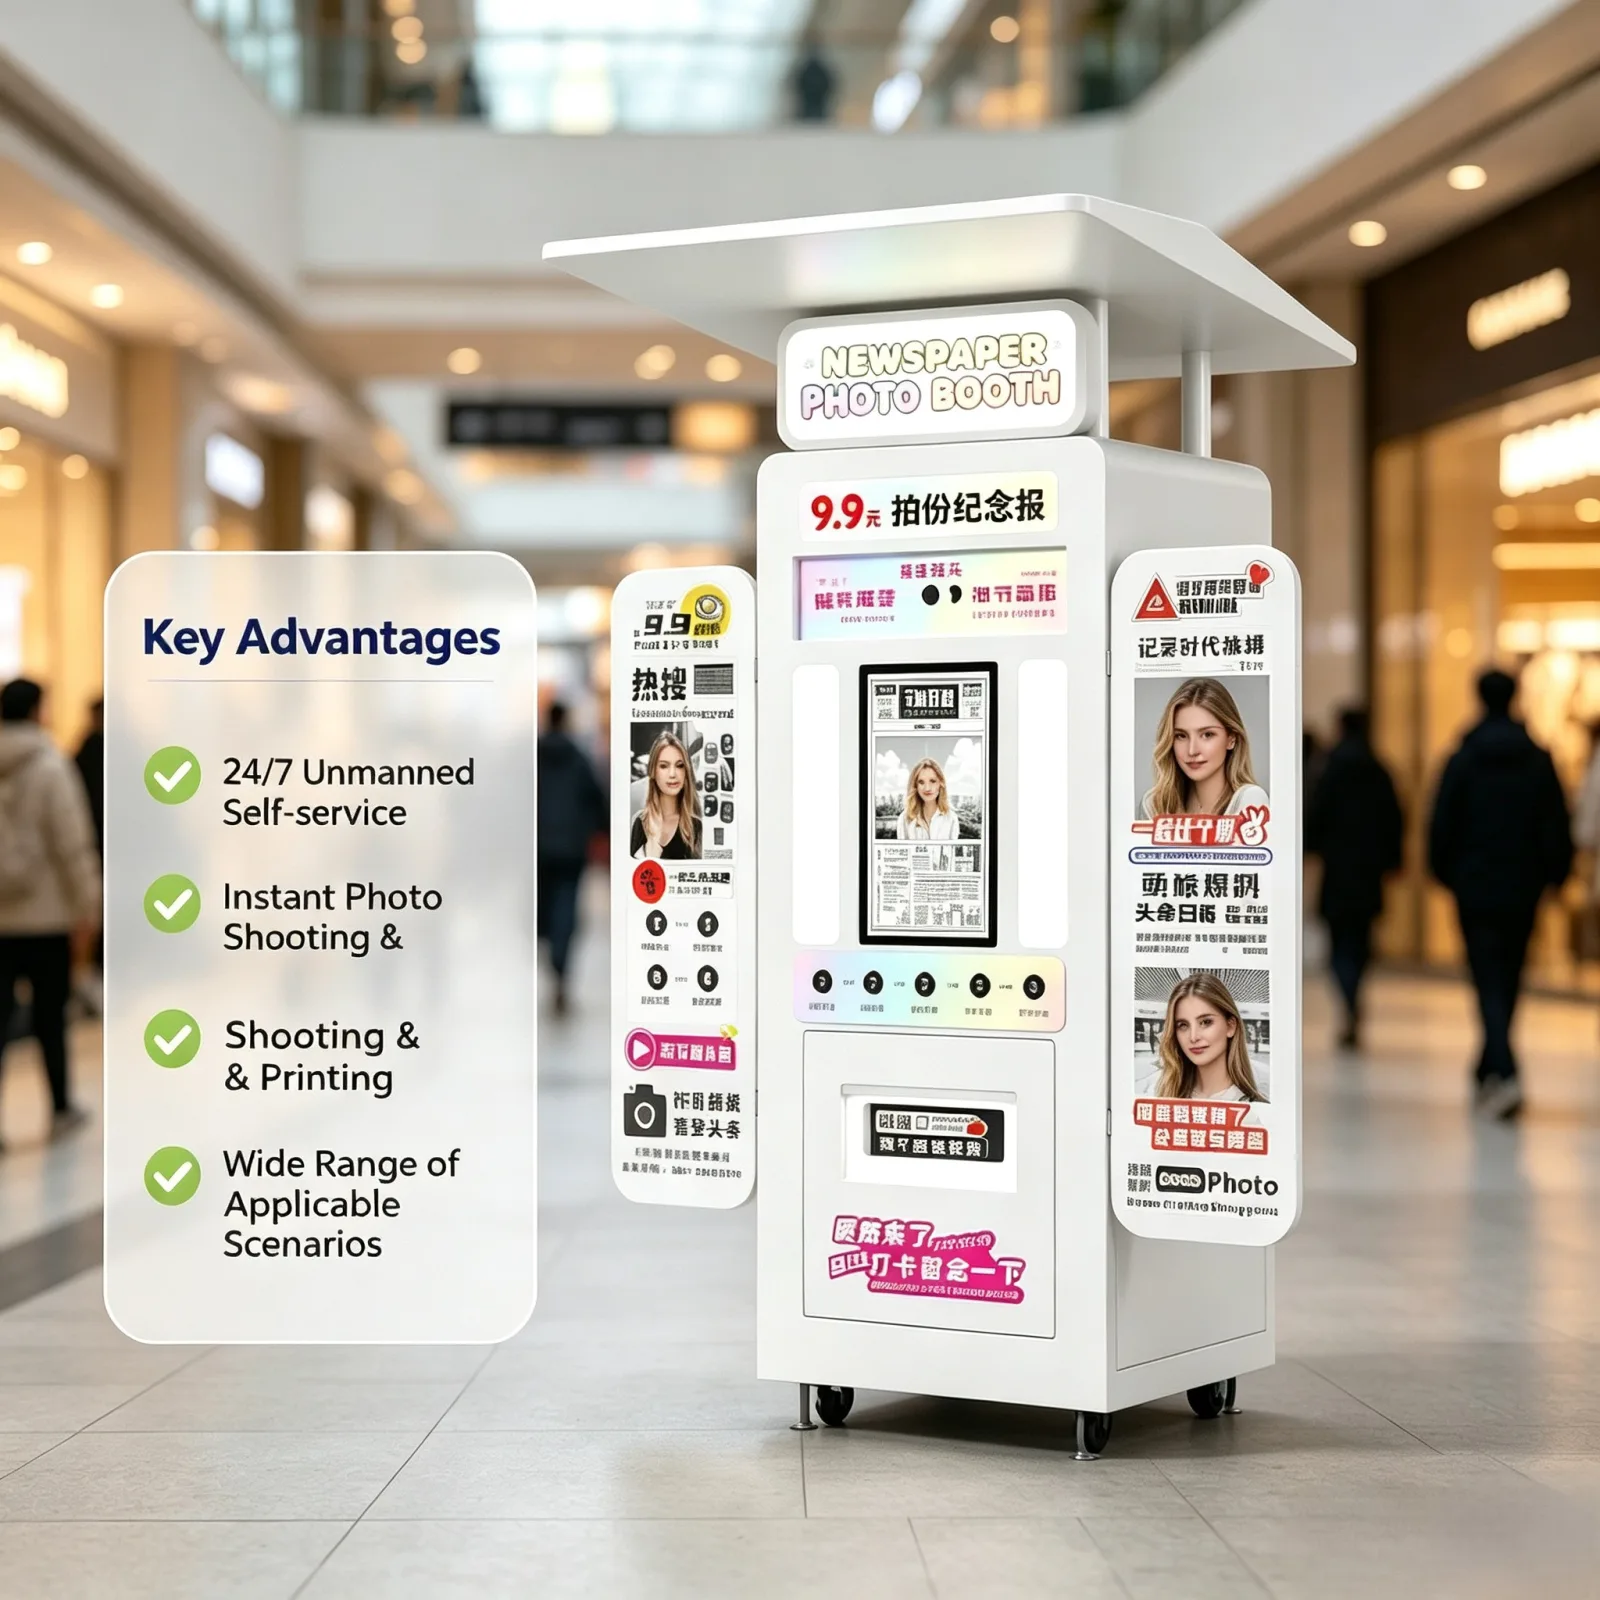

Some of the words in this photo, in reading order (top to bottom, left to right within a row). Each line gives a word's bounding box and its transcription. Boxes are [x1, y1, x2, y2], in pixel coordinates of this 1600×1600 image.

[821, 332, 1048, 379] NEWSPAPER
[801, 379, 921, 420] PHOTO
[931, 369, 1061, 413] BOOTH
[892, 488, 1045, 527] 拍份纪念报
[1208, 1170, 1279, 1196] Photo
